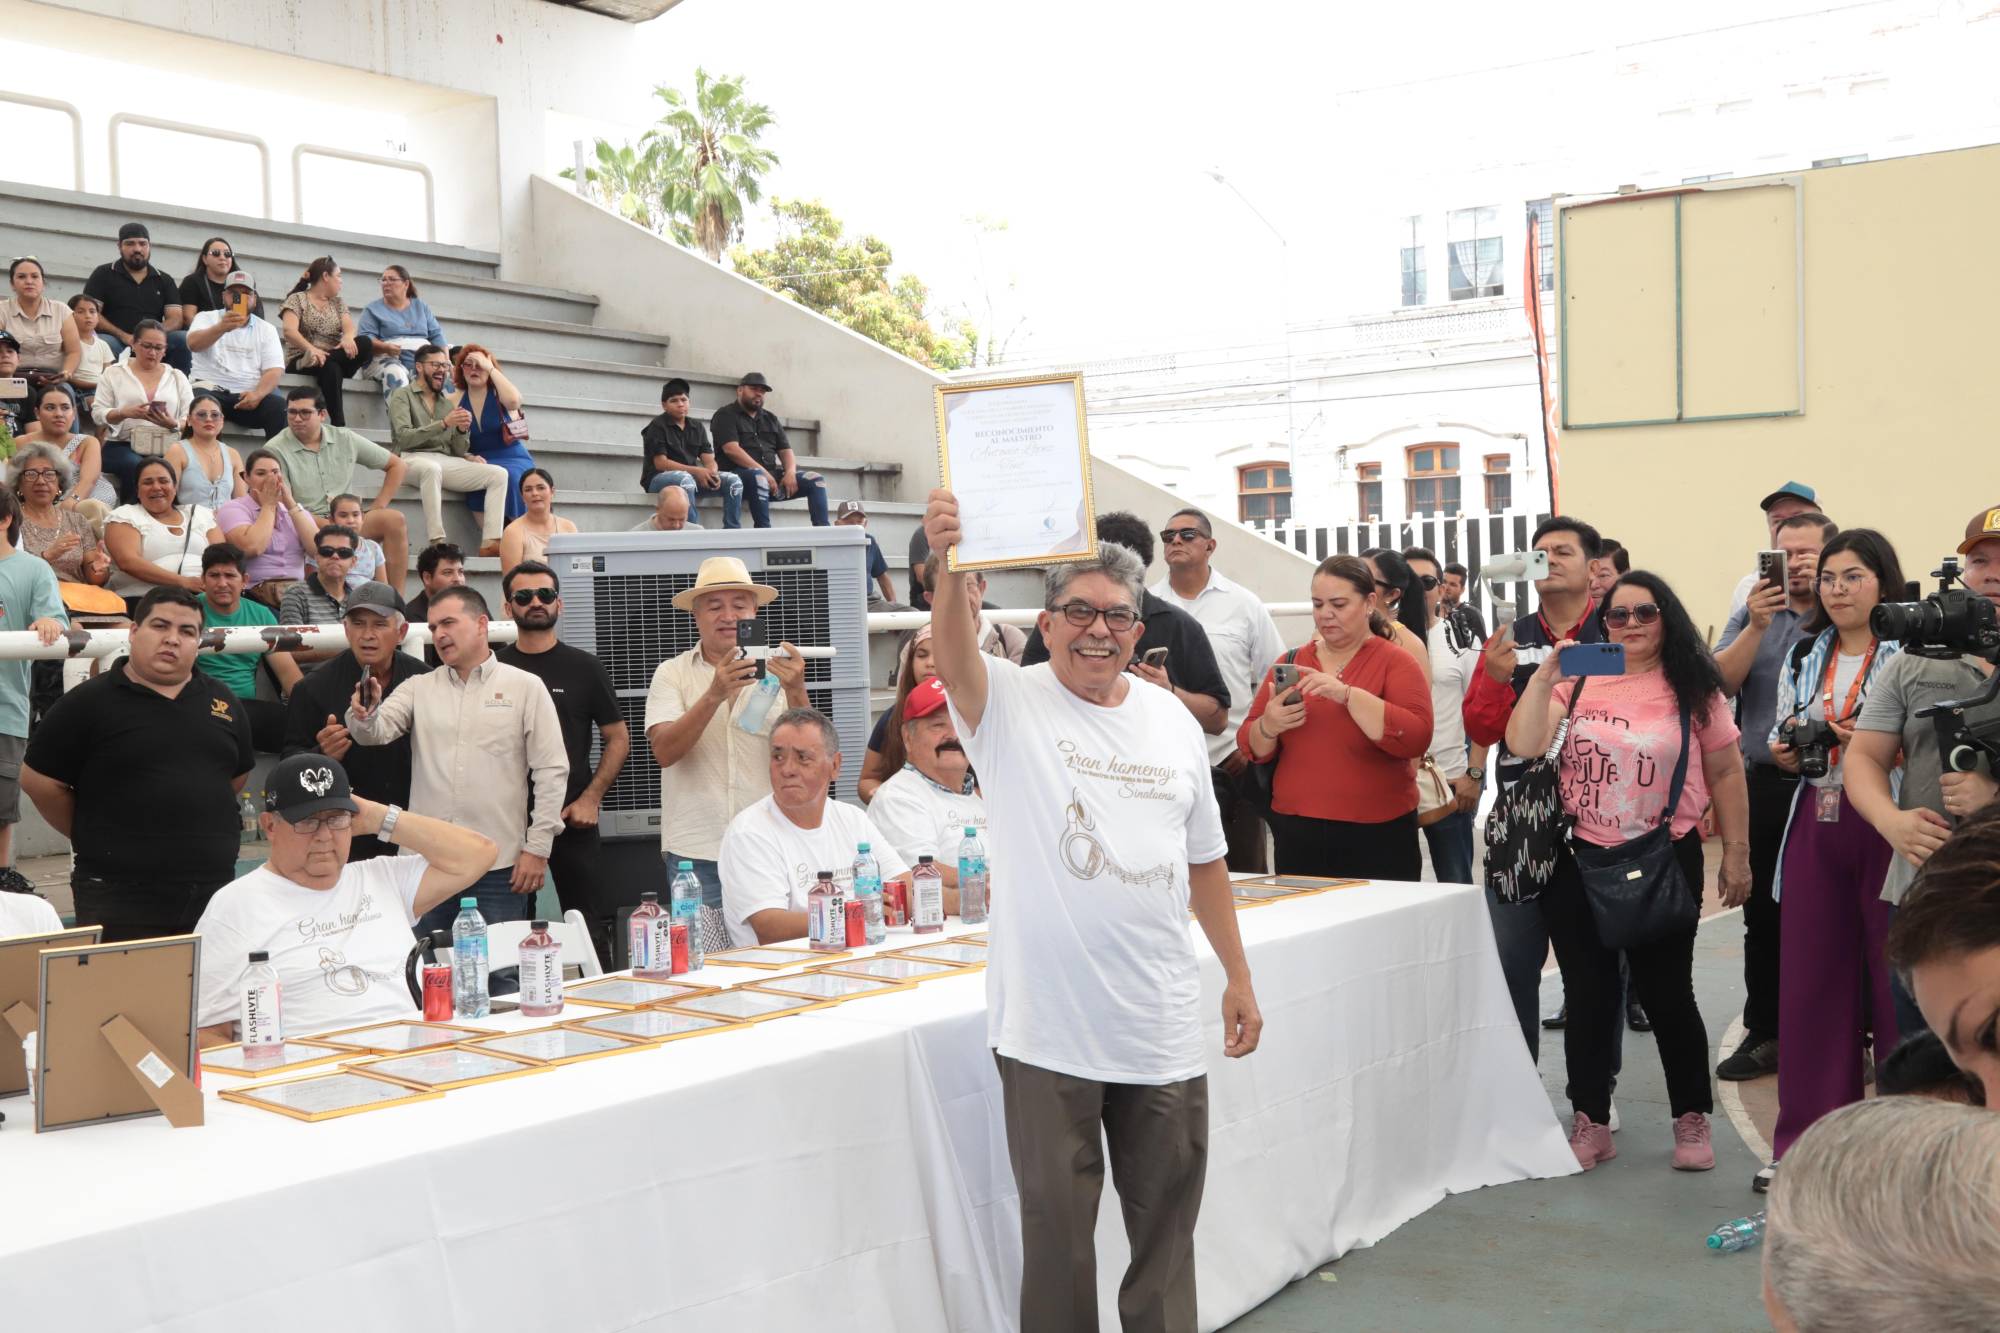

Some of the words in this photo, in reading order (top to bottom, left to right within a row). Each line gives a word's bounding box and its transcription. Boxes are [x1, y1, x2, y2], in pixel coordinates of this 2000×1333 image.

[1057, 739, 1102, 770] Gran
[1107, 754, 1177, 786] homenaje
[1118, 782, 1177, 802] Sinaloense
[297, 916, 337, 944] Gran
[544, 952, 553, 1004] FLASHLYTE
[247, 988, 258, 1044] FLASHLYTE
